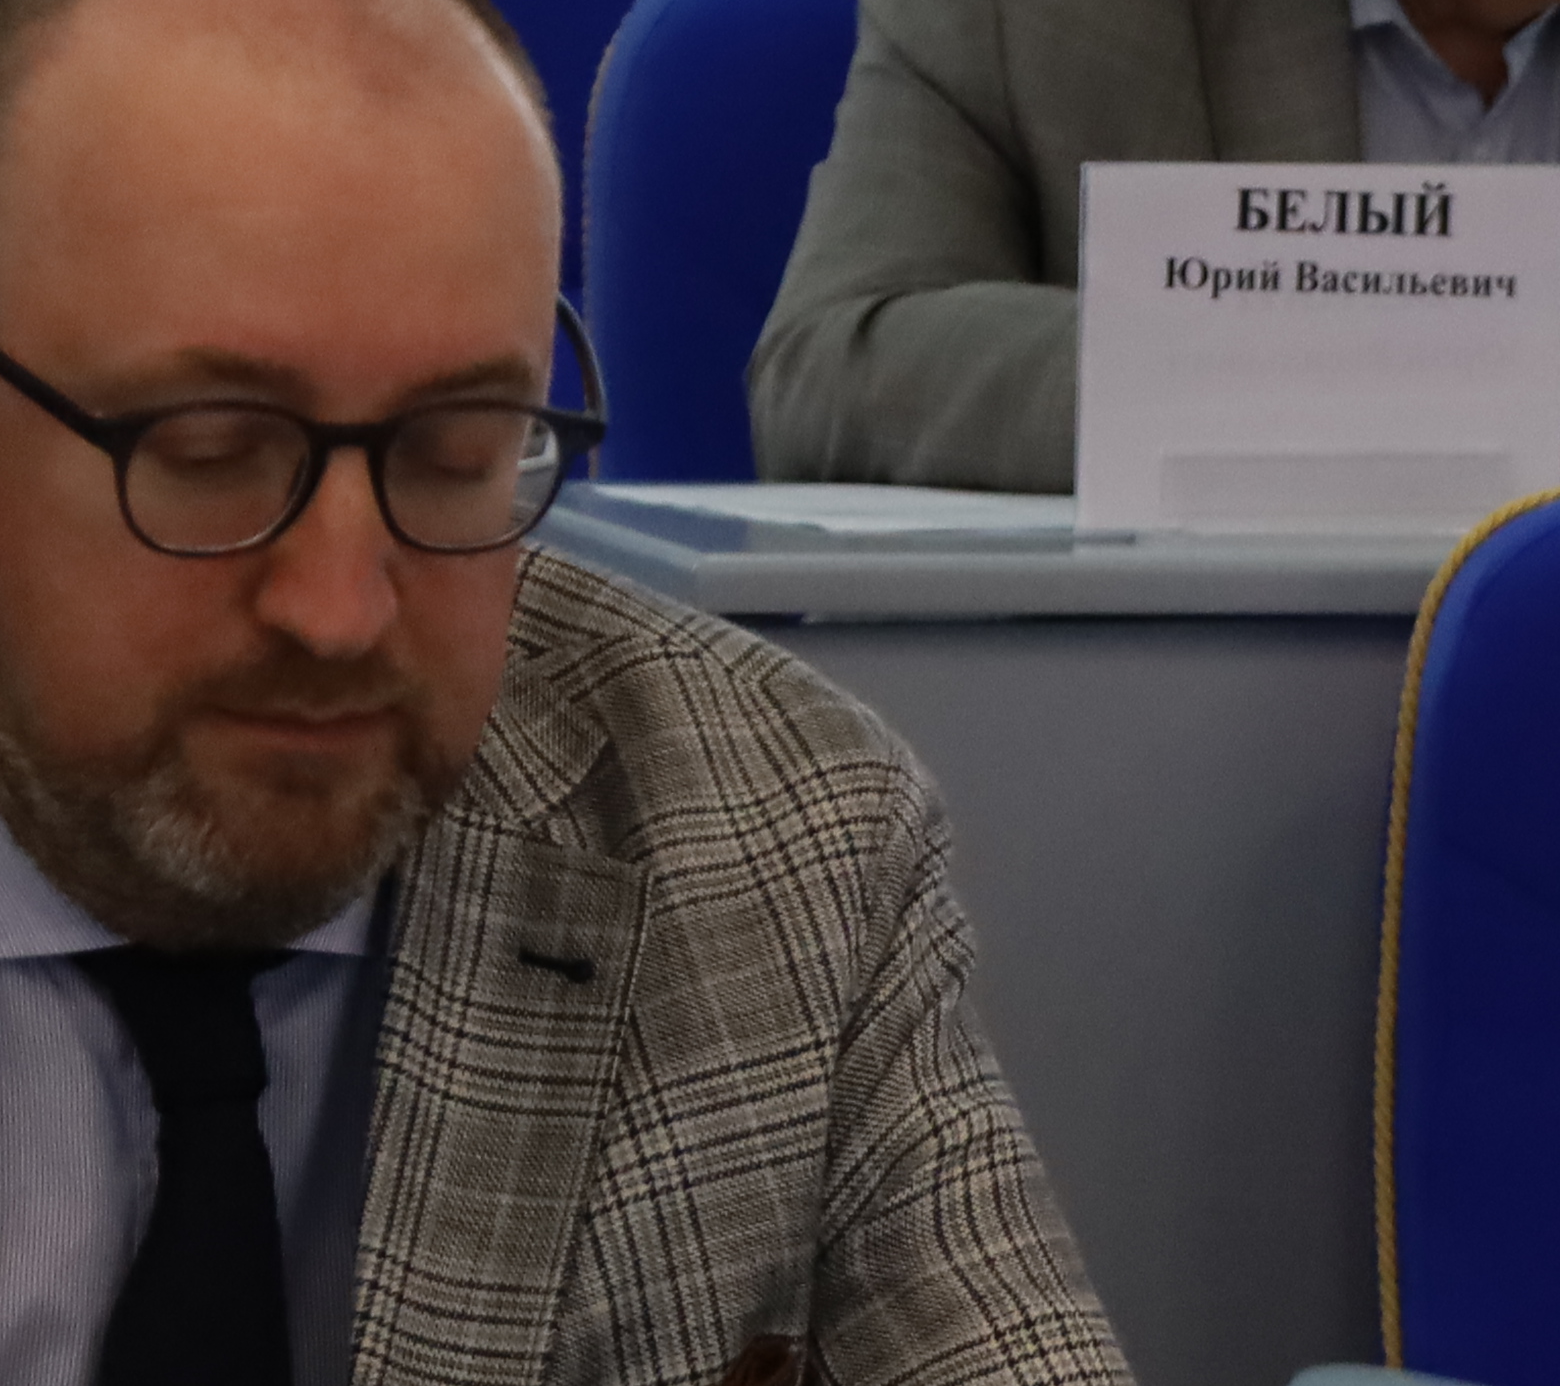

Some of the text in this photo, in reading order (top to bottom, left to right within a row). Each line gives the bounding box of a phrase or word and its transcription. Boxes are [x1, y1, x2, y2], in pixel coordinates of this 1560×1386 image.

[1236, 181, 1453, 237] БЕЛЫЙ
[1165, 256, 1517, 300] Юрий Васильевич
